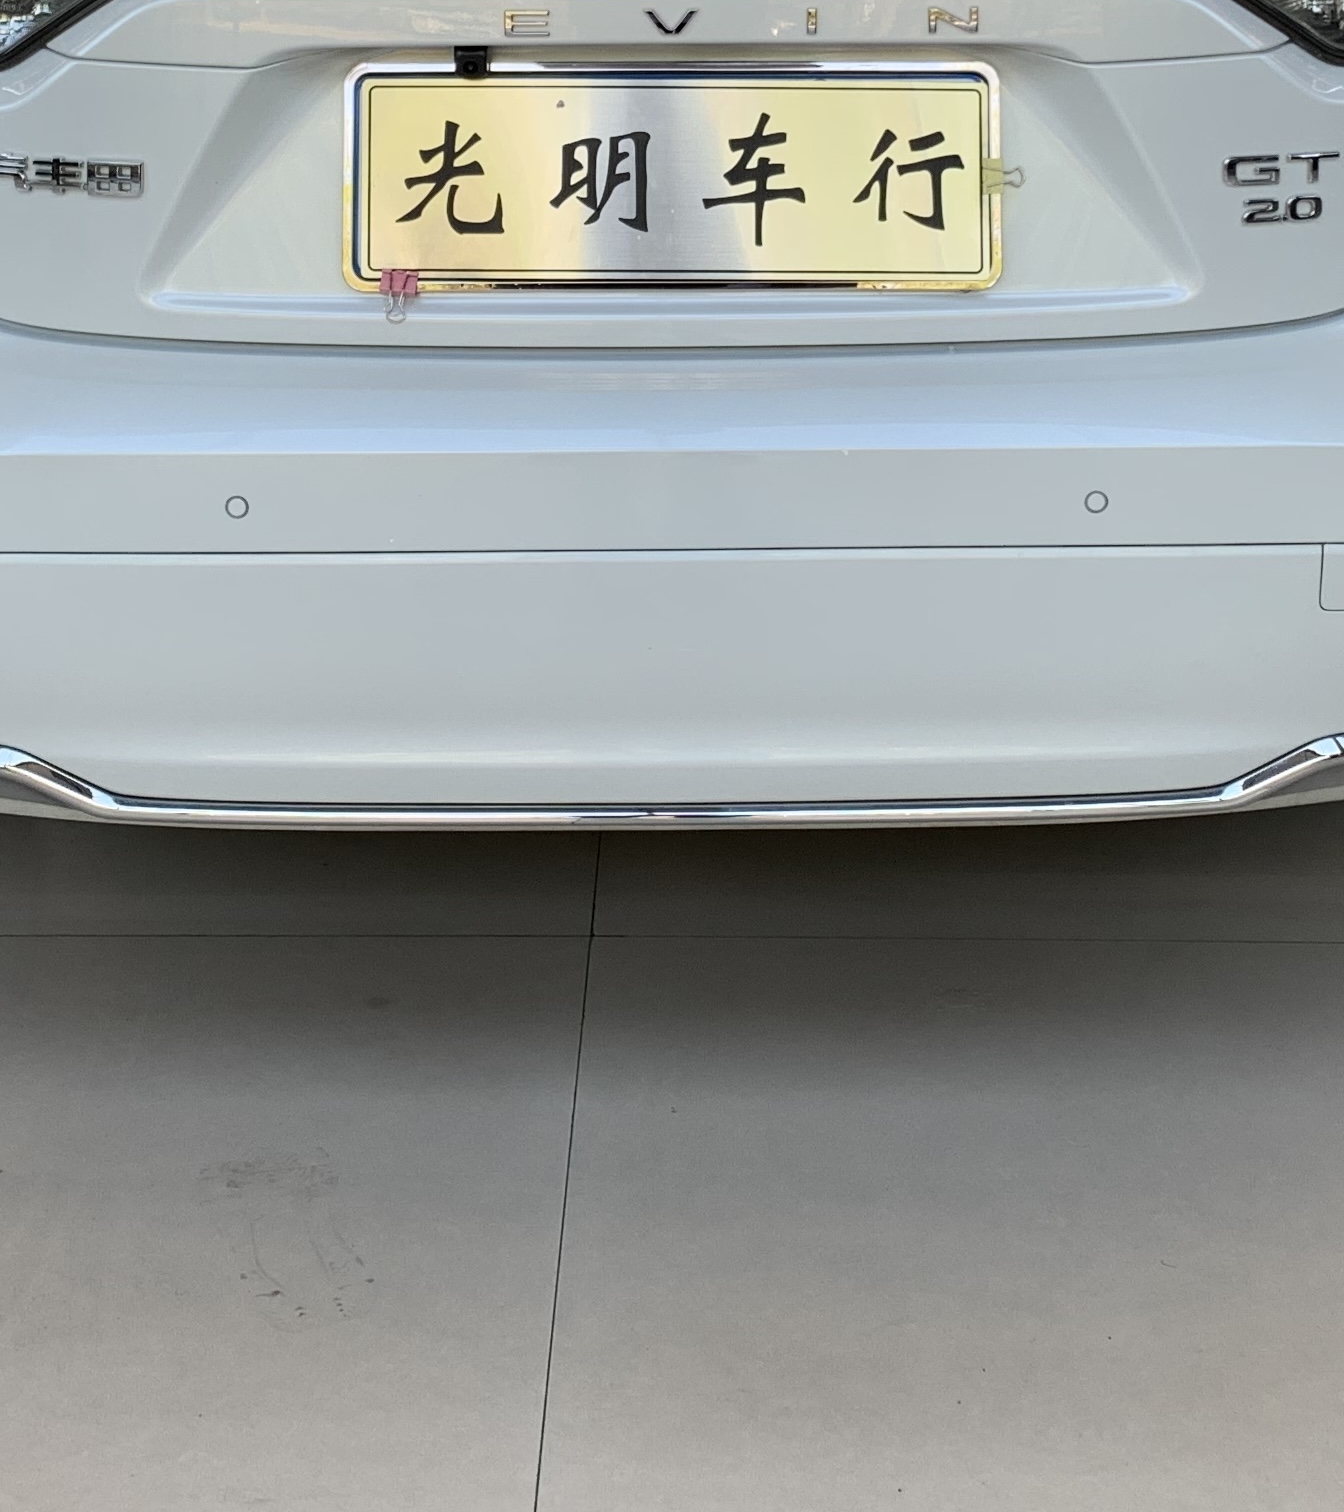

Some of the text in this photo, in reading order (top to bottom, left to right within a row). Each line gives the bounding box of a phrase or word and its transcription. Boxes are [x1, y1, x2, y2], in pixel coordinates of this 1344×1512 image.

[395, 112, 966, 247] 光明车行
[1222, 150, 1341, 187] GT
[1241, 194, 1324, 226] 2.0
